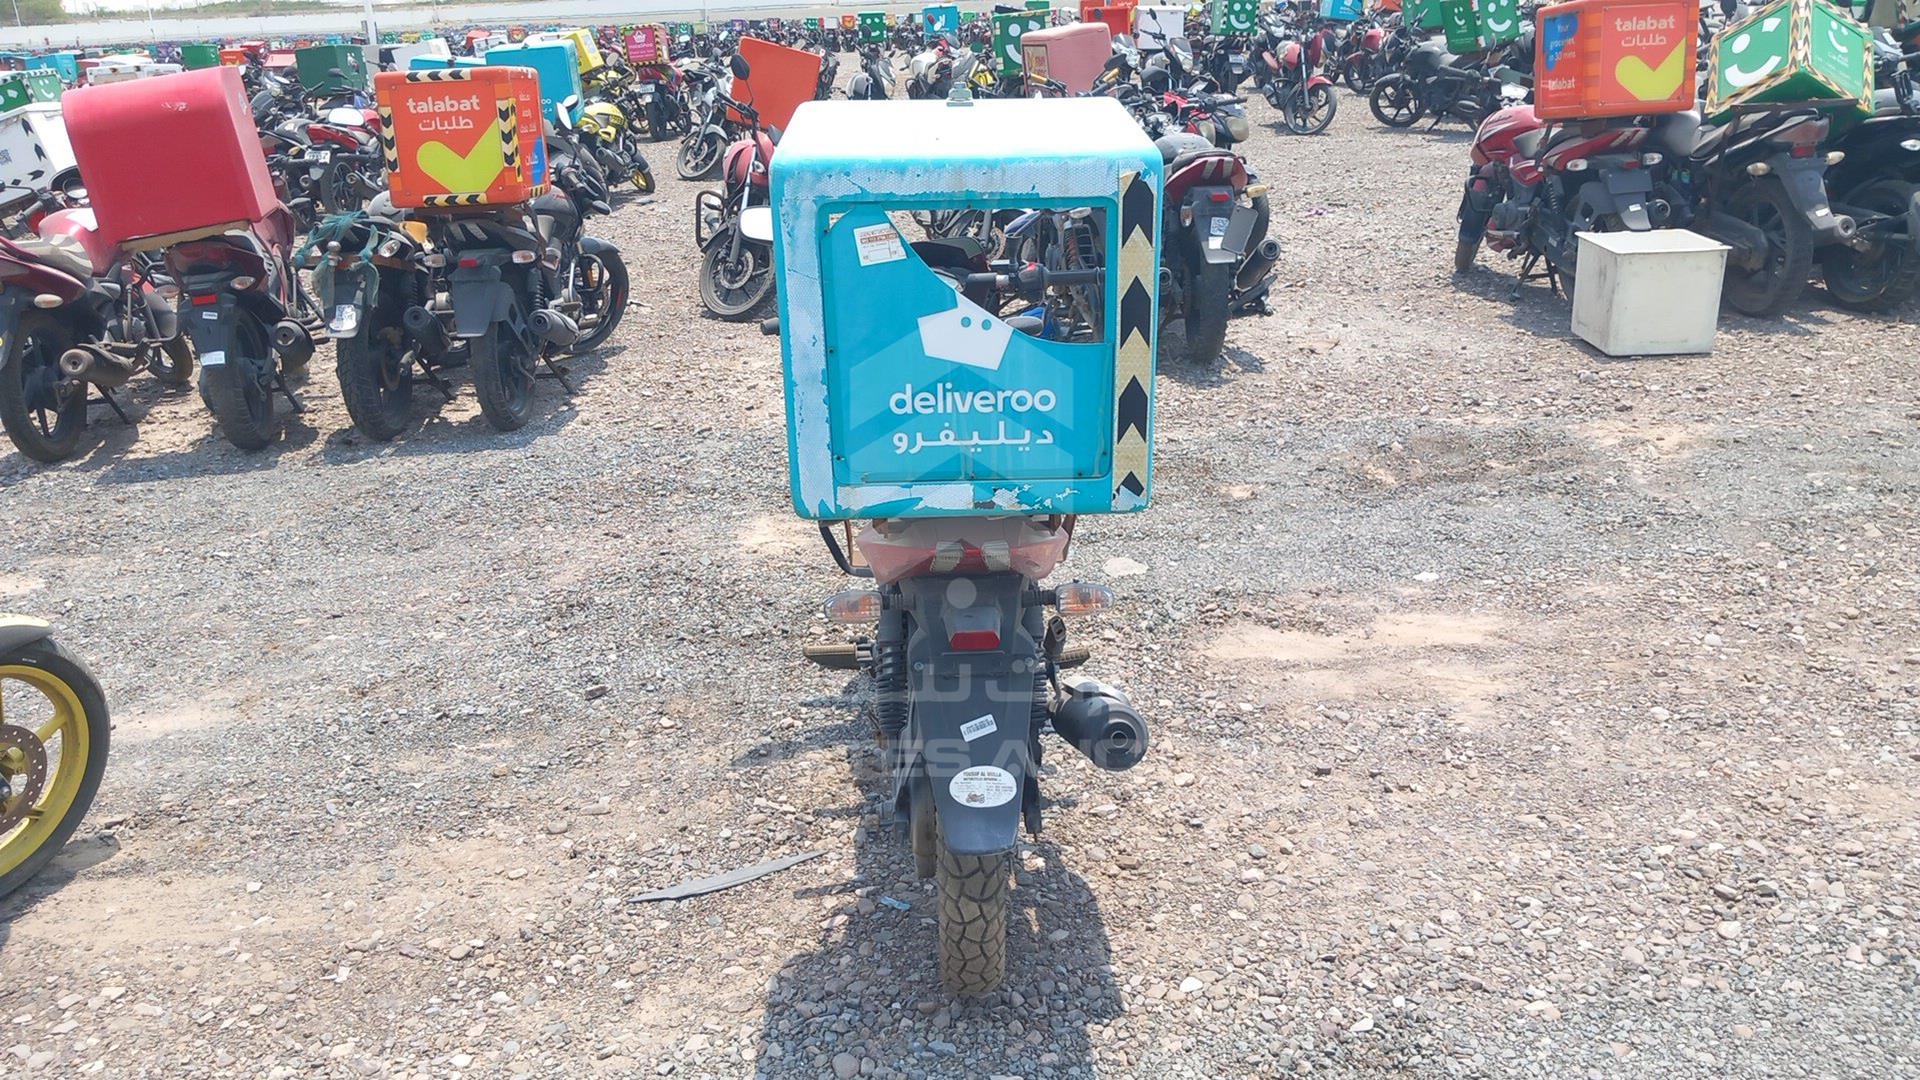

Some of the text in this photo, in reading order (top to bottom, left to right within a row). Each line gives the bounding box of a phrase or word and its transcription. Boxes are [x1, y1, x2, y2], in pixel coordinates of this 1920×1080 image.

[1615, 15, 1676, 32] talabat
[1621, 33, 1667, 50] طلبات
[406, 95, 481, 114] talabat
[418, 116, 474, 134] طلبات
[889, 382, 1057, 415] deliveroo
[892, 420, 1055, 455] ديليفرو
